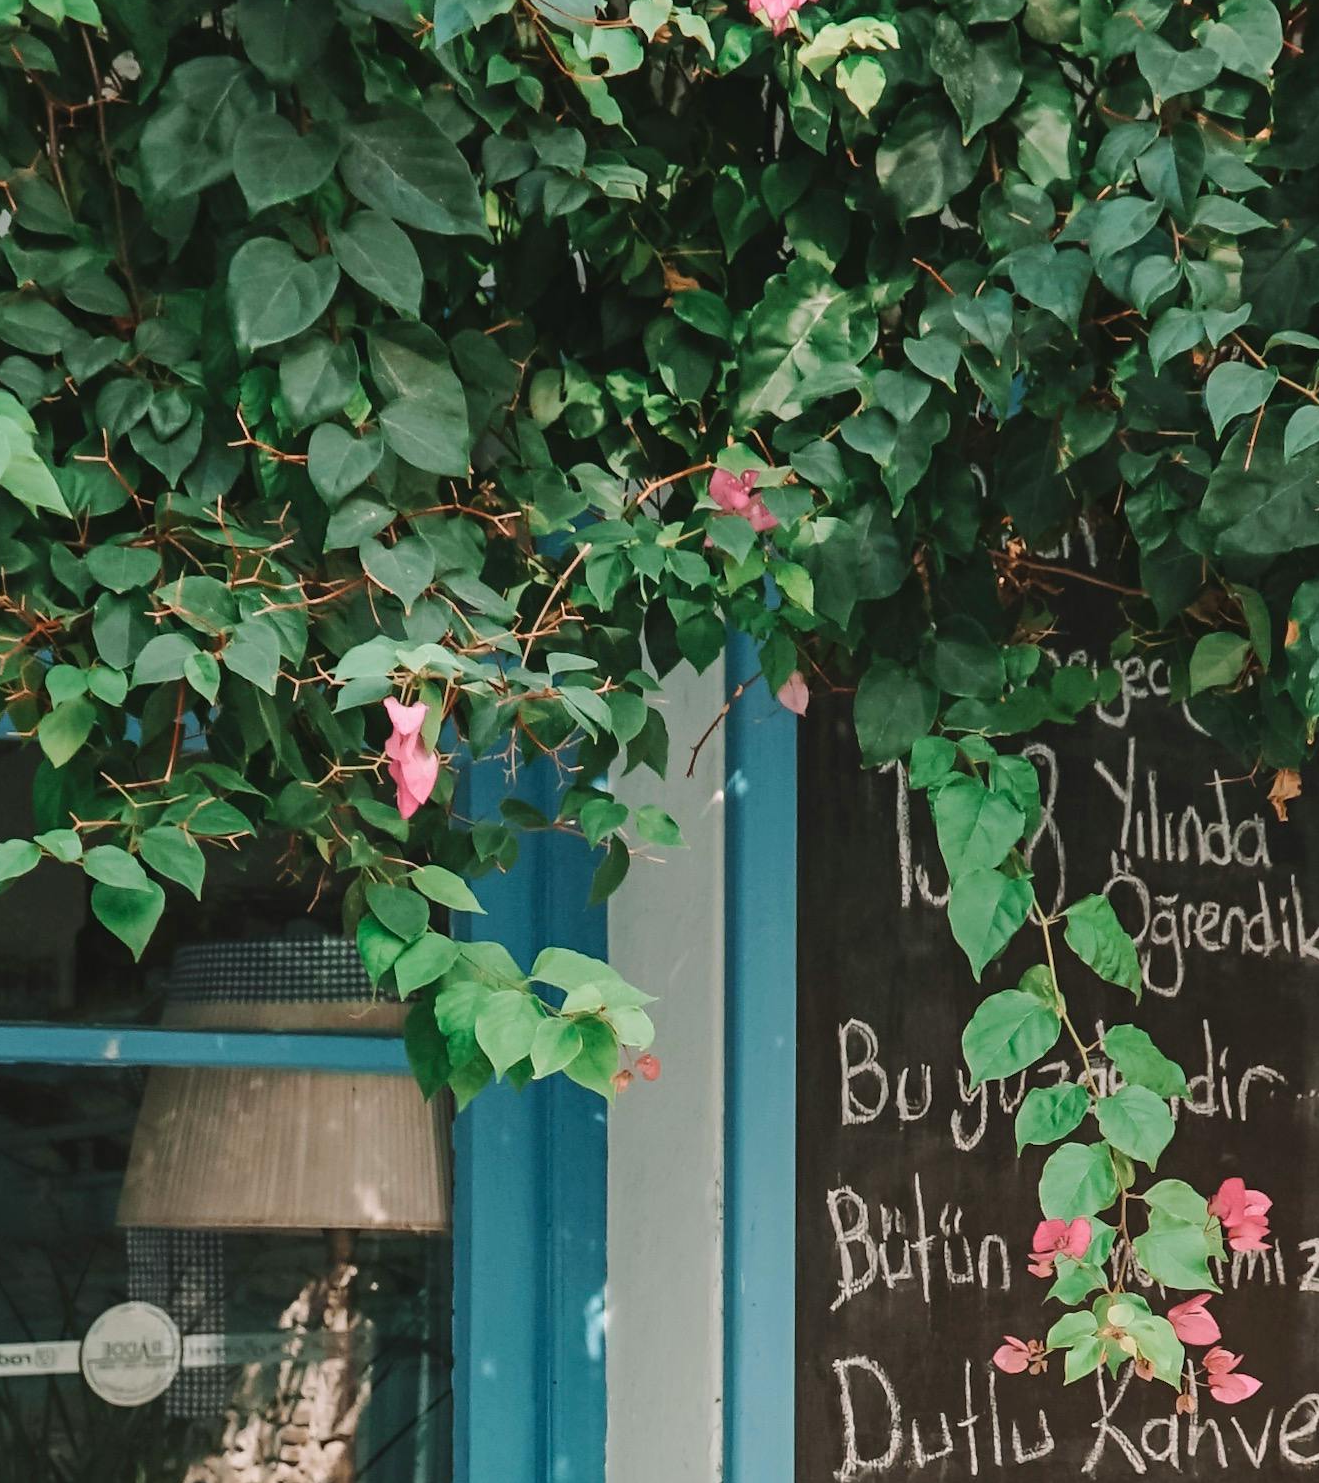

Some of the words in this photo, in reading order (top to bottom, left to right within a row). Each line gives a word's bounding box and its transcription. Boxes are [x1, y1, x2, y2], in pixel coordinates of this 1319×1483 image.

[1094, 737, 1273, 868] Yılında
[838, 1018, 932, 1127] Bu
[827, 1172, 1011, 1312] Bütün
[832, 1354, 1056, 1482] Dutlu
